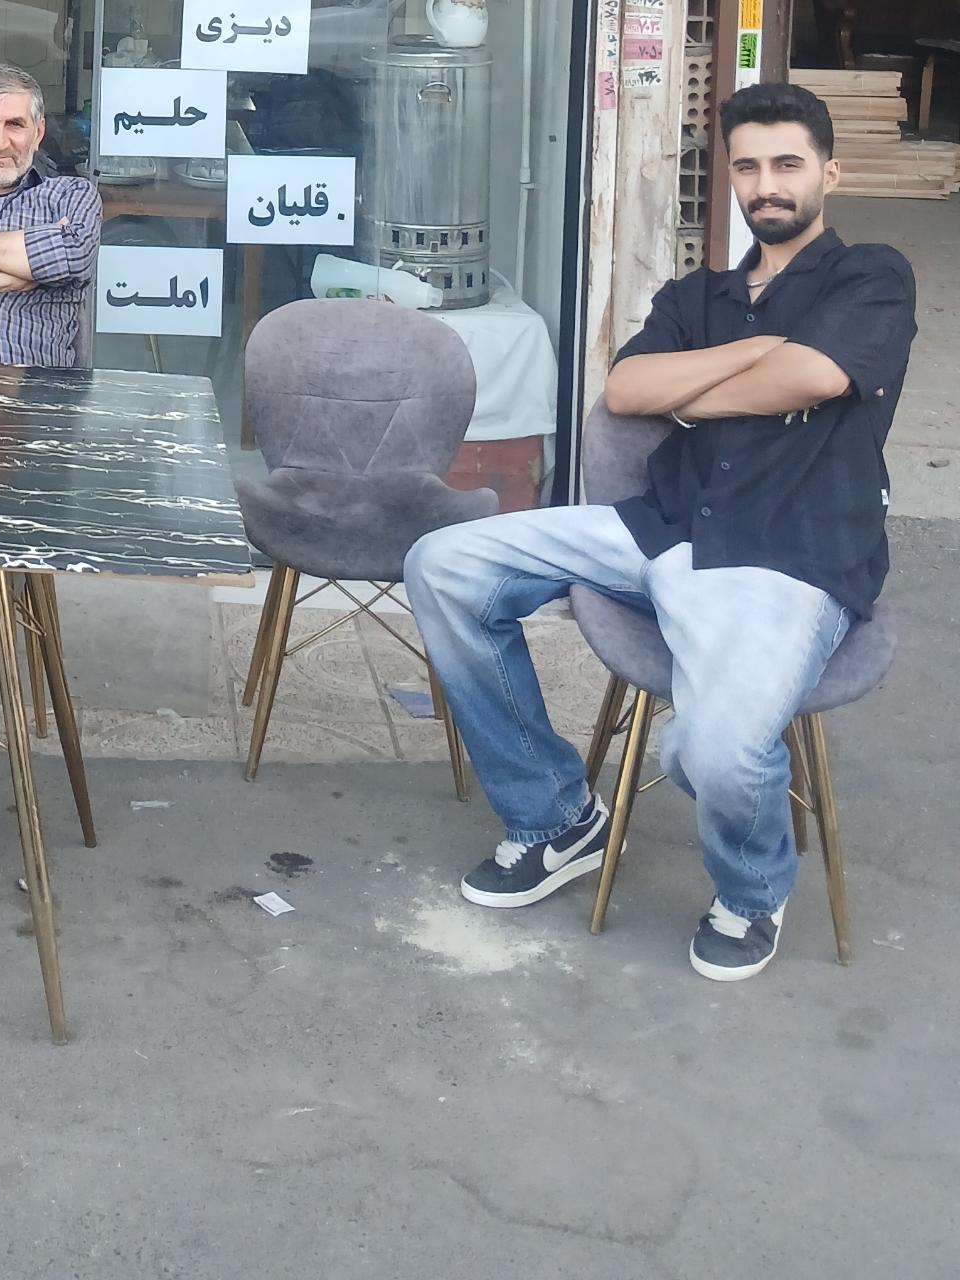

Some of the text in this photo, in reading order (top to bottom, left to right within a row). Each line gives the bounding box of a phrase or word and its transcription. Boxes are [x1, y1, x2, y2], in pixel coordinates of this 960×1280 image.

[195, 11, 292, 45] دیزی
[112, 96, 209, 136] حلیم
[247, 182, 330, 229] قلیان
[106, 275, 210, 311] املت
